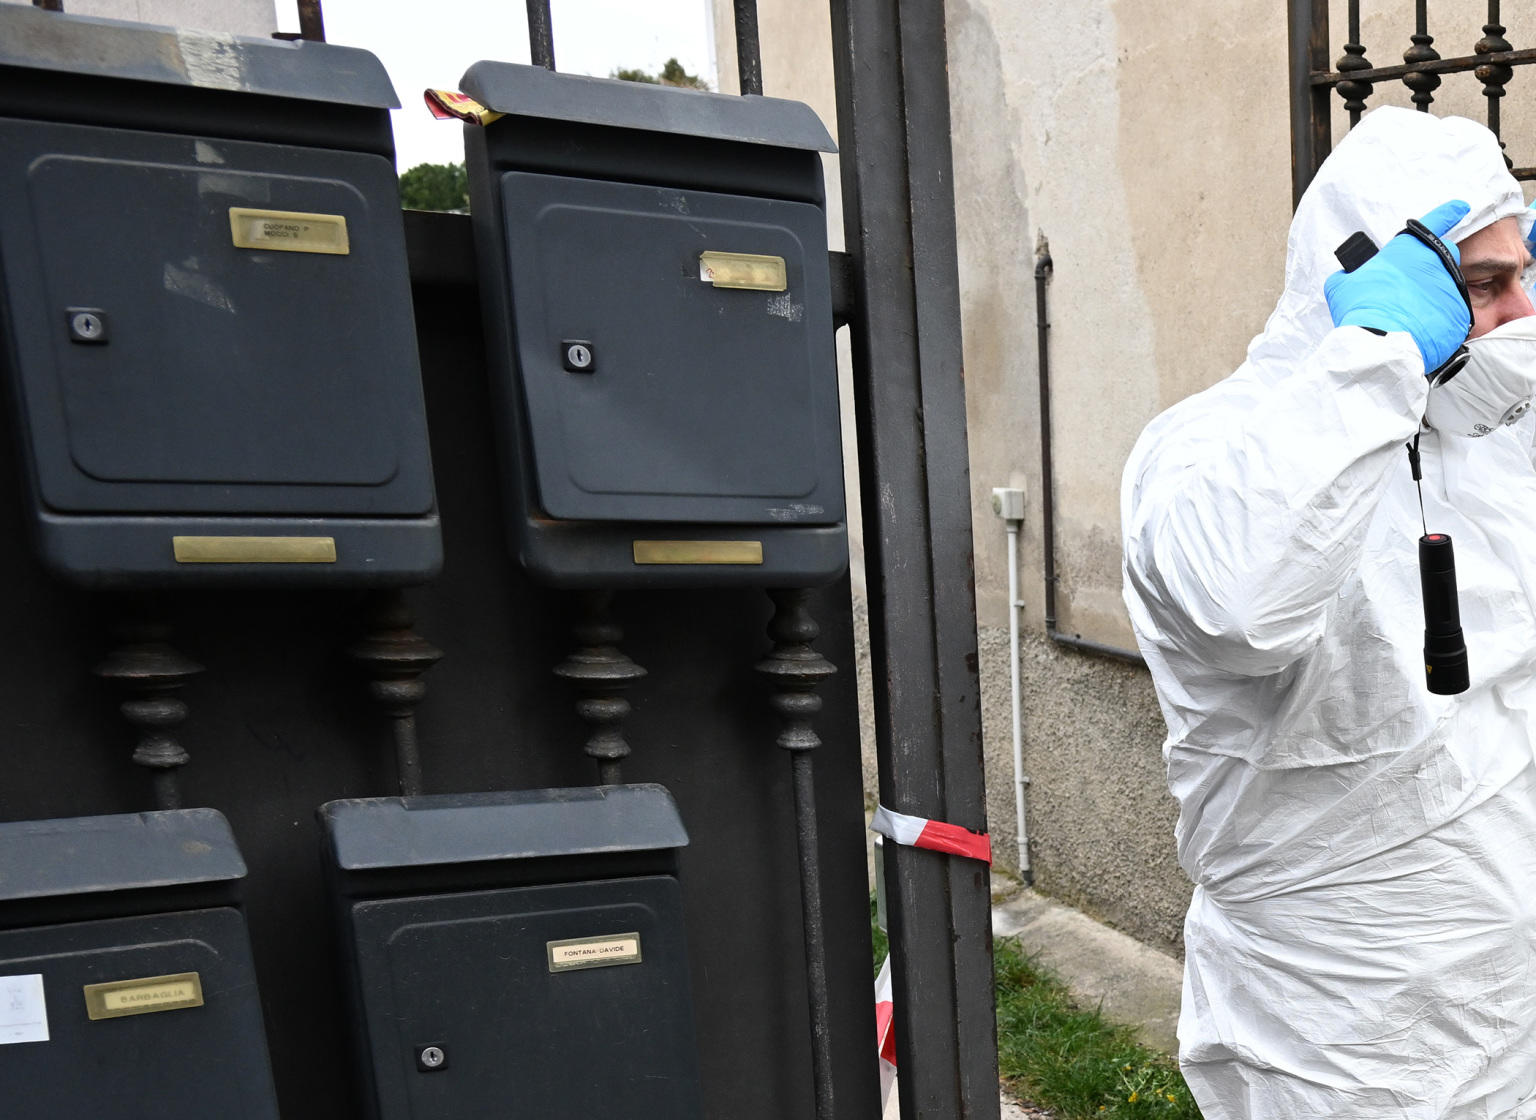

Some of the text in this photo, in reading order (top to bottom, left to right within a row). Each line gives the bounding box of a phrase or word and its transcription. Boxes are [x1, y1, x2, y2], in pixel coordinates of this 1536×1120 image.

[564, 945, 625, 957] FONTANA DAVIDE
[120, 989, 185, 1003] BARBAGLIA
